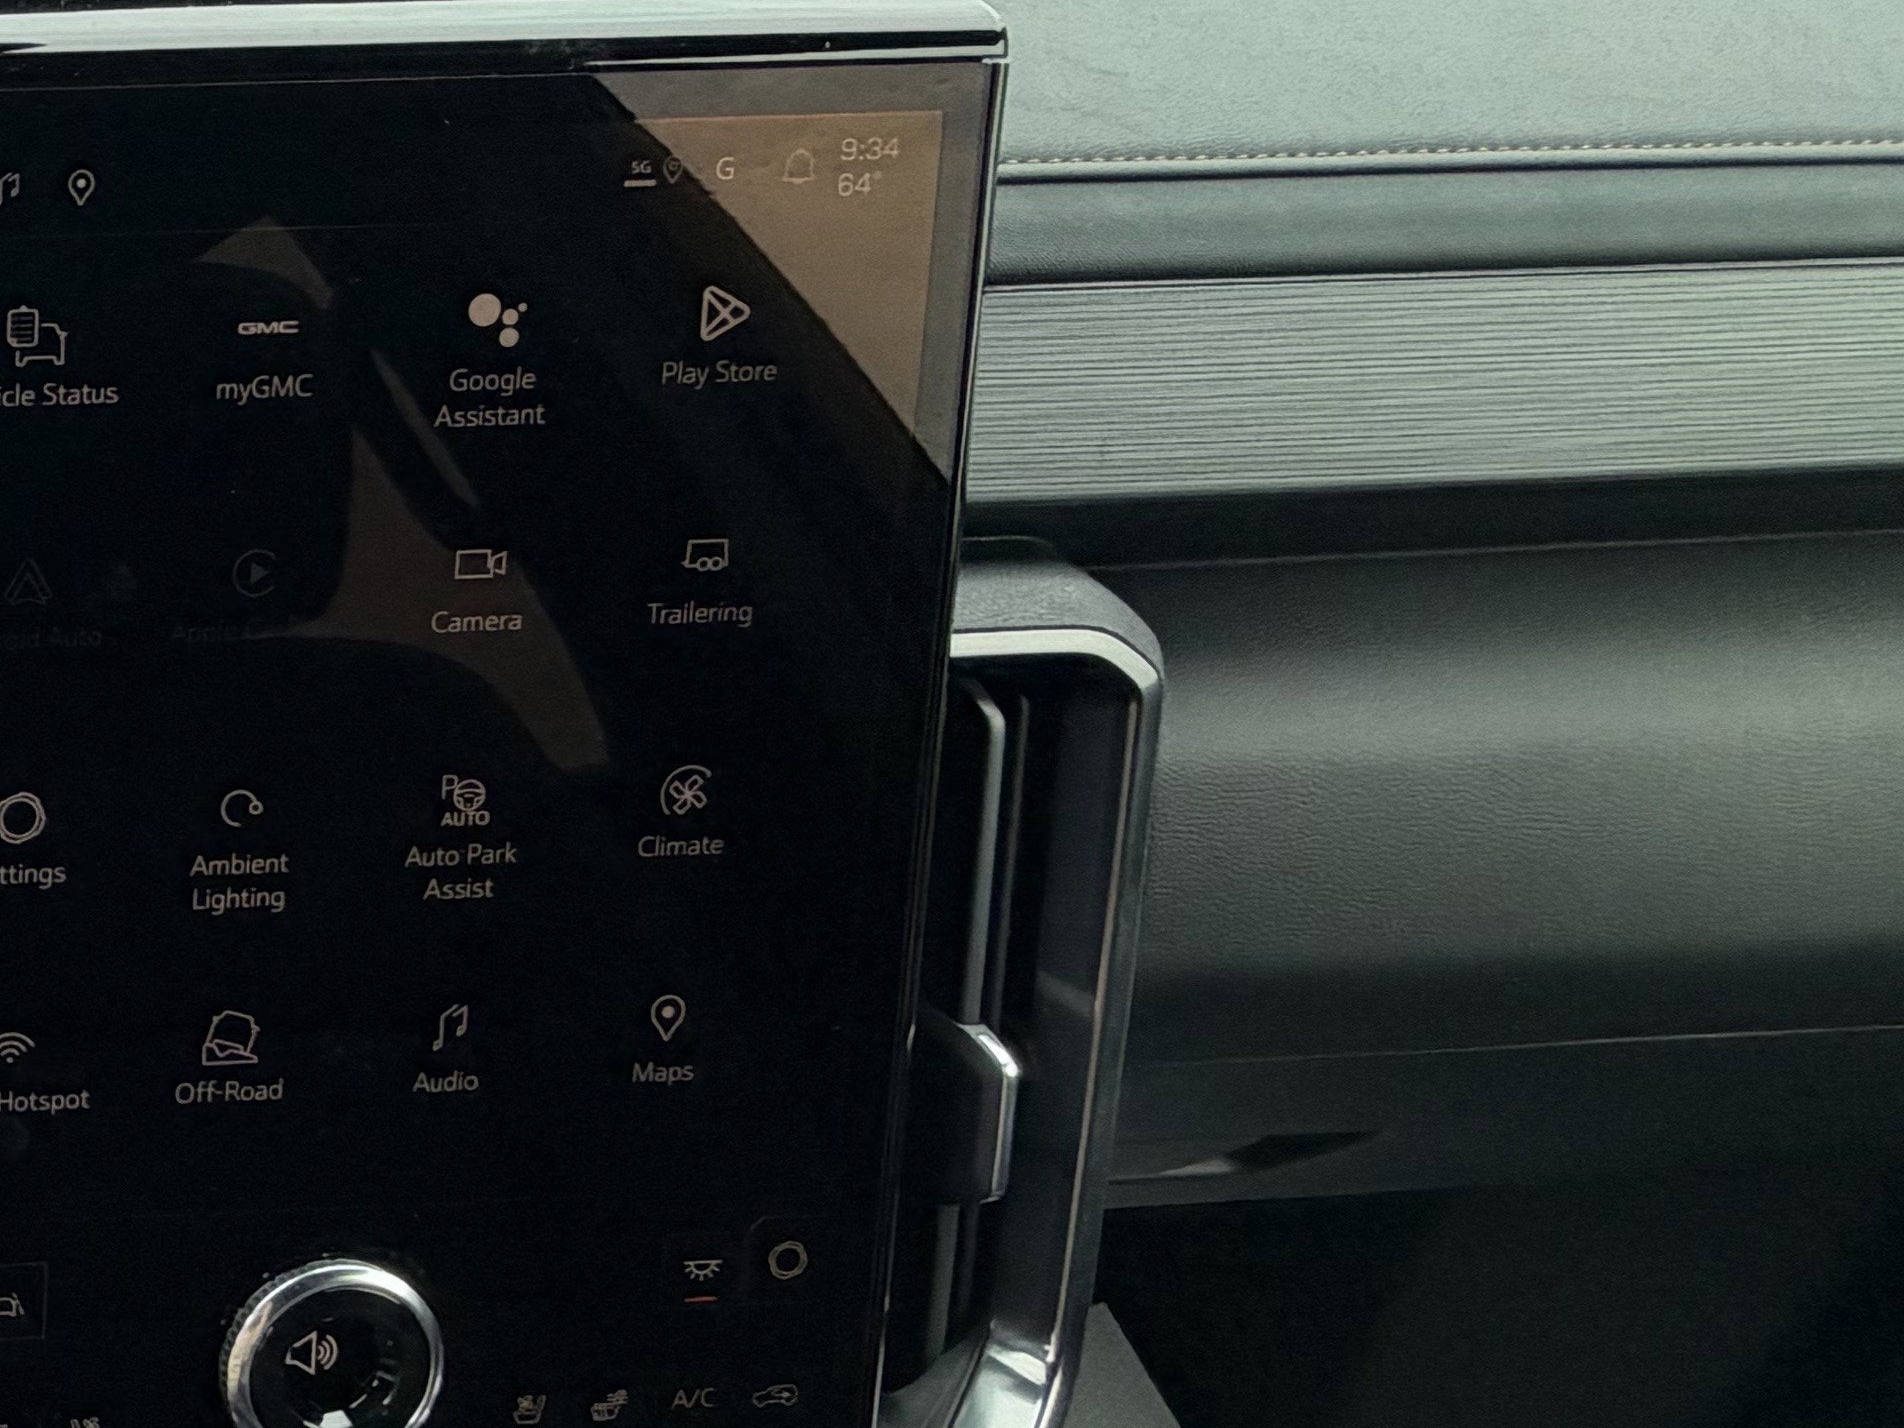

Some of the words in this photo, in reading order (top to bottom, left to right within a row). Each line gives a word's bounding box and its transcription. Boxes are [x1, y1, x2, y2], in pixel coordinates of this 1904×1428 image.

[840, 137, 900, 161] 9:34
[237, 320, 299, 335] GMC
[450, 366, 537, 399] Google
[662, 361, 709, 389] Play
[716, 360, 777, 383] Store
[42, 382, 119, 406] Status
[216, 373, 313, 405] myGMC
[434, 402, 545, 428] Assistant
[431, 609, 523, 633] Camera
[648, 600, 753, 628] Trailering
[441, 809, 490, 827] AUTO
[405, 844, 460, 868] Auto
[468, 842, 516, 865] Park
[638, 835, 724, 858] Climate
[190, 853, 288, 877] Ambient
[192, 887, 285, 915] Lighting
[423, 878, 493, 900] Assist
[413, 1070, 479, 1093] Audio
[632, 1062, 694, 1087] Maps
[175, 1079, 284, 1105] Off-Road
[672, 1387, 715, 1410] A/C
